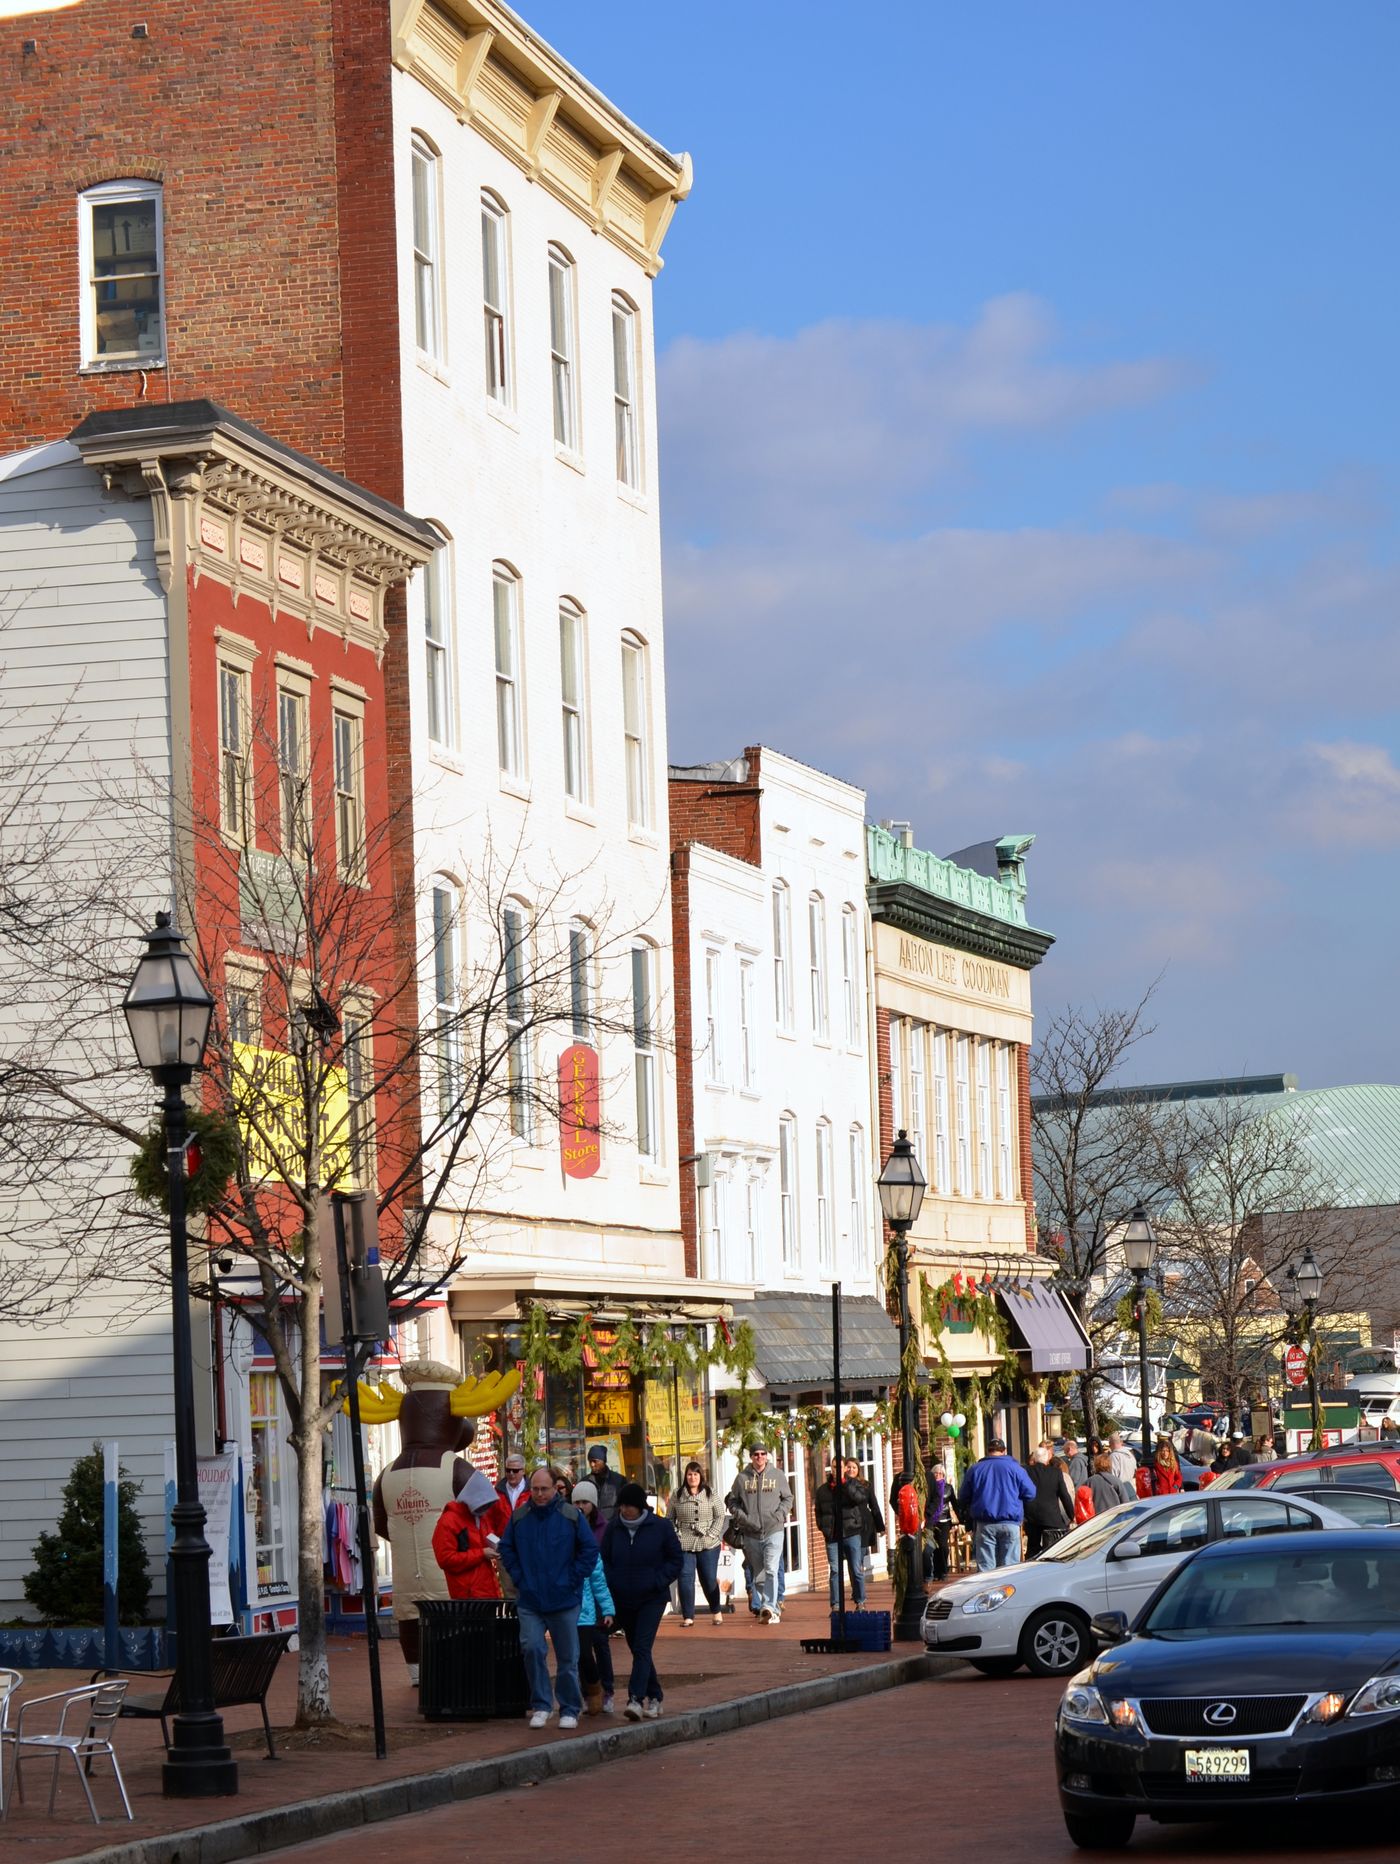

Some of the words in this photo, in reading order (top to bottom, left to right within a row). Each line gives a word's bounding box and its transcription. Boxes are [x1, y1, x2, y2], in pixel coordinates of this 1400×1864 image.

[899, 937, 933, 977] AARON
[935, 949, 957, 985] LEE
[962, 958, 1009, 999] GOODMAN
[573, 1050, 588, 1144] GENERAL
[291, 1105, 330, 1146] RET
[564, 1143, 599, 1161] Store
[587, 1412, 625, 1425] CHEN
[1186, 1775, 1217, 1783] SILVER
[1218, 1774, 1250, 1782] SPRING
